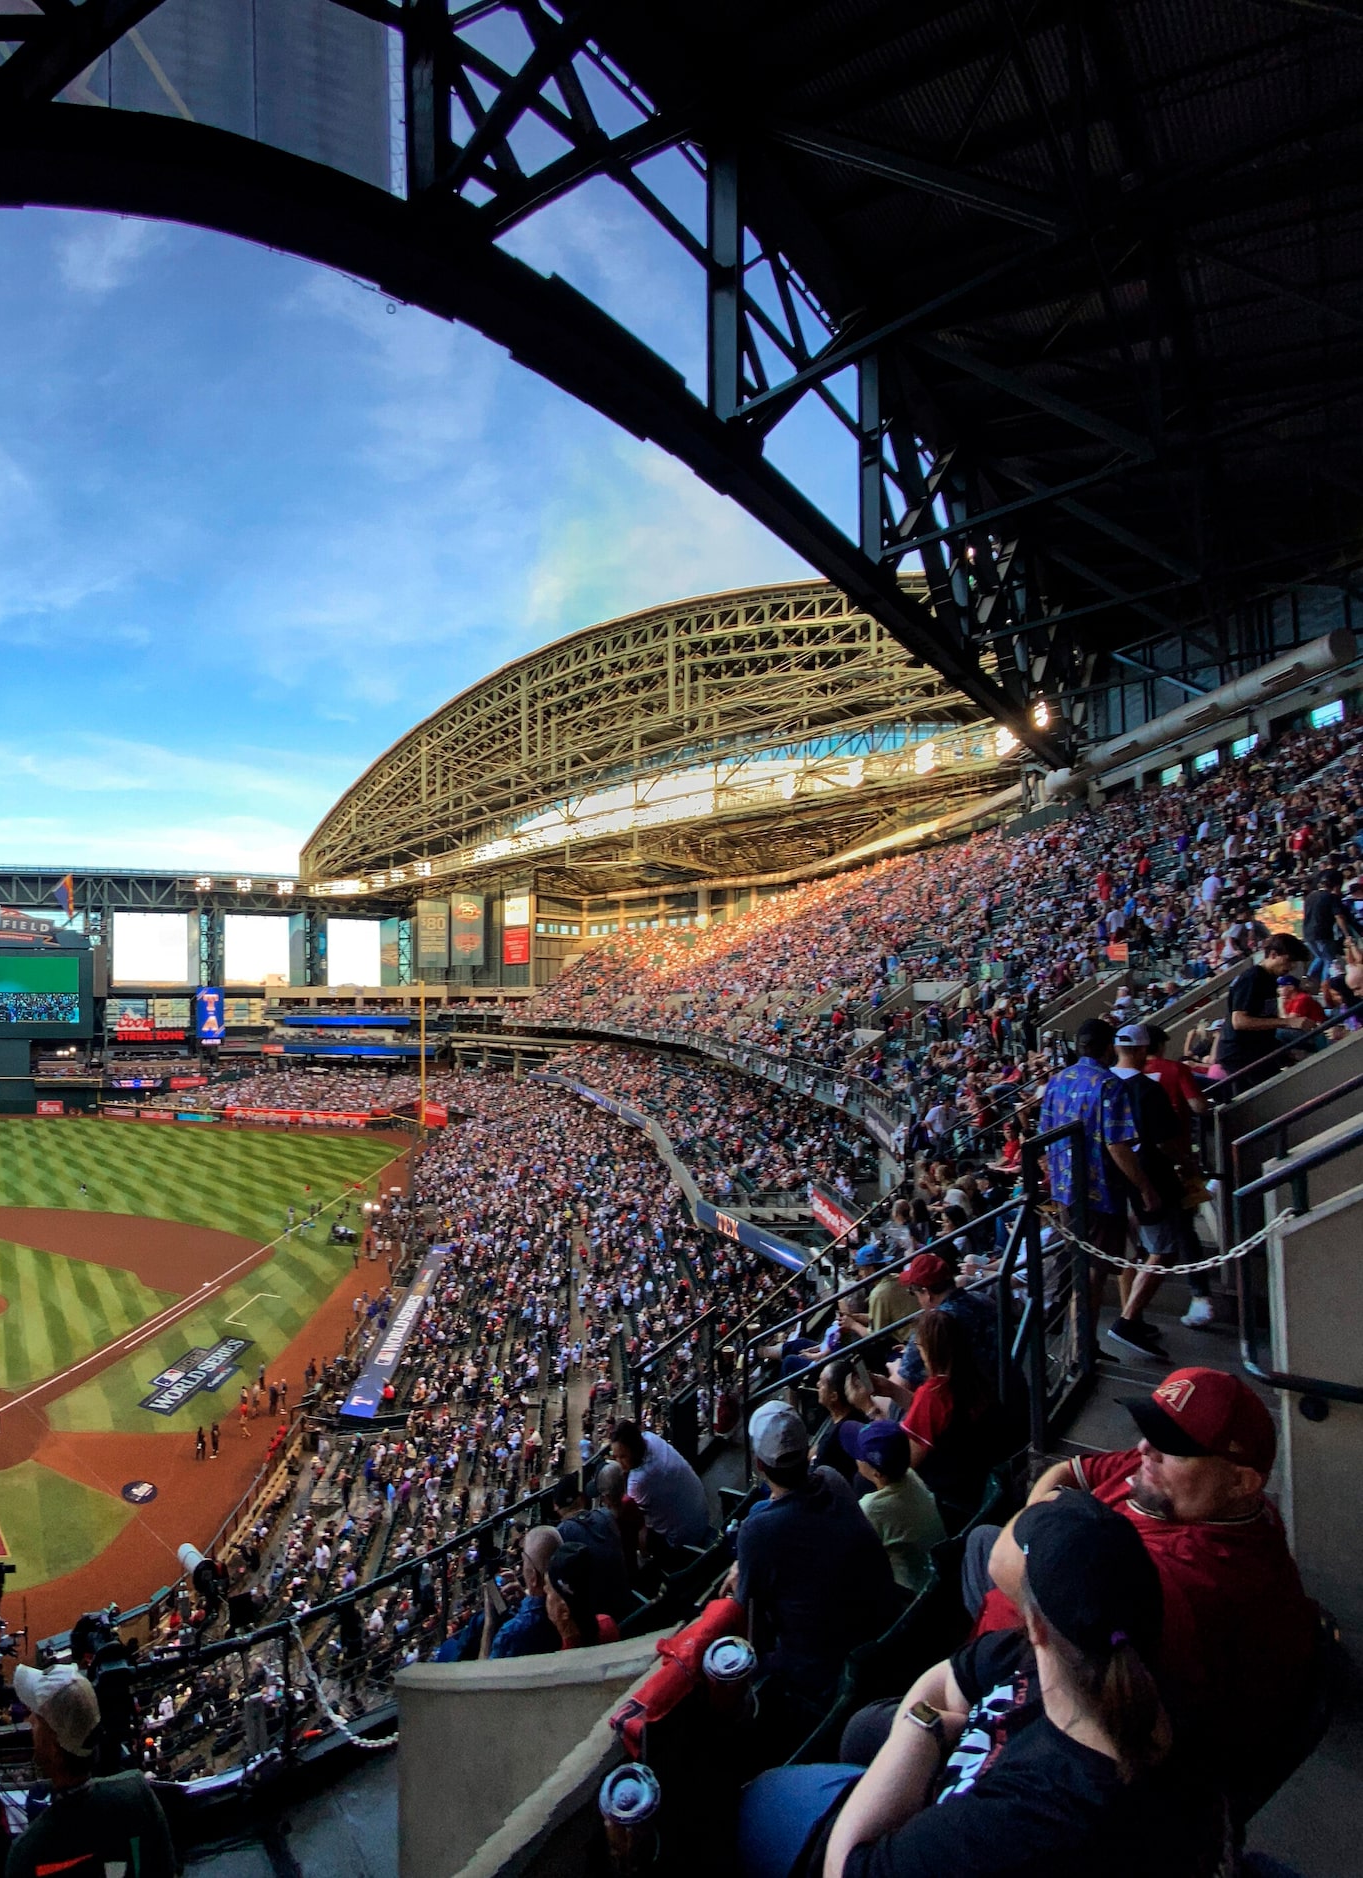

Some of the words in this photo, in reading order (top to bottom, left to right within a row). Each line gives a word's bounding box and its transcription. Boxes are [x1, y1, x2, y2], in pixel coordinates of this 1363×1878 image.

[2, 919, 50, 932] FIELD
[421, 917, 446, 930] $80
[117, 1031, 154, 1040] STRIKE
[156, 1030, 185, 1040] ZONE
[716, 1211, 740, 1241] TEX
[383, 1317, 410, 1352] WORLD
[399, 1294, 424, 1321] SERIES
[149, 1370, 208, 1409] WORLD
[197, 1339, 245, 1373] SERIES
